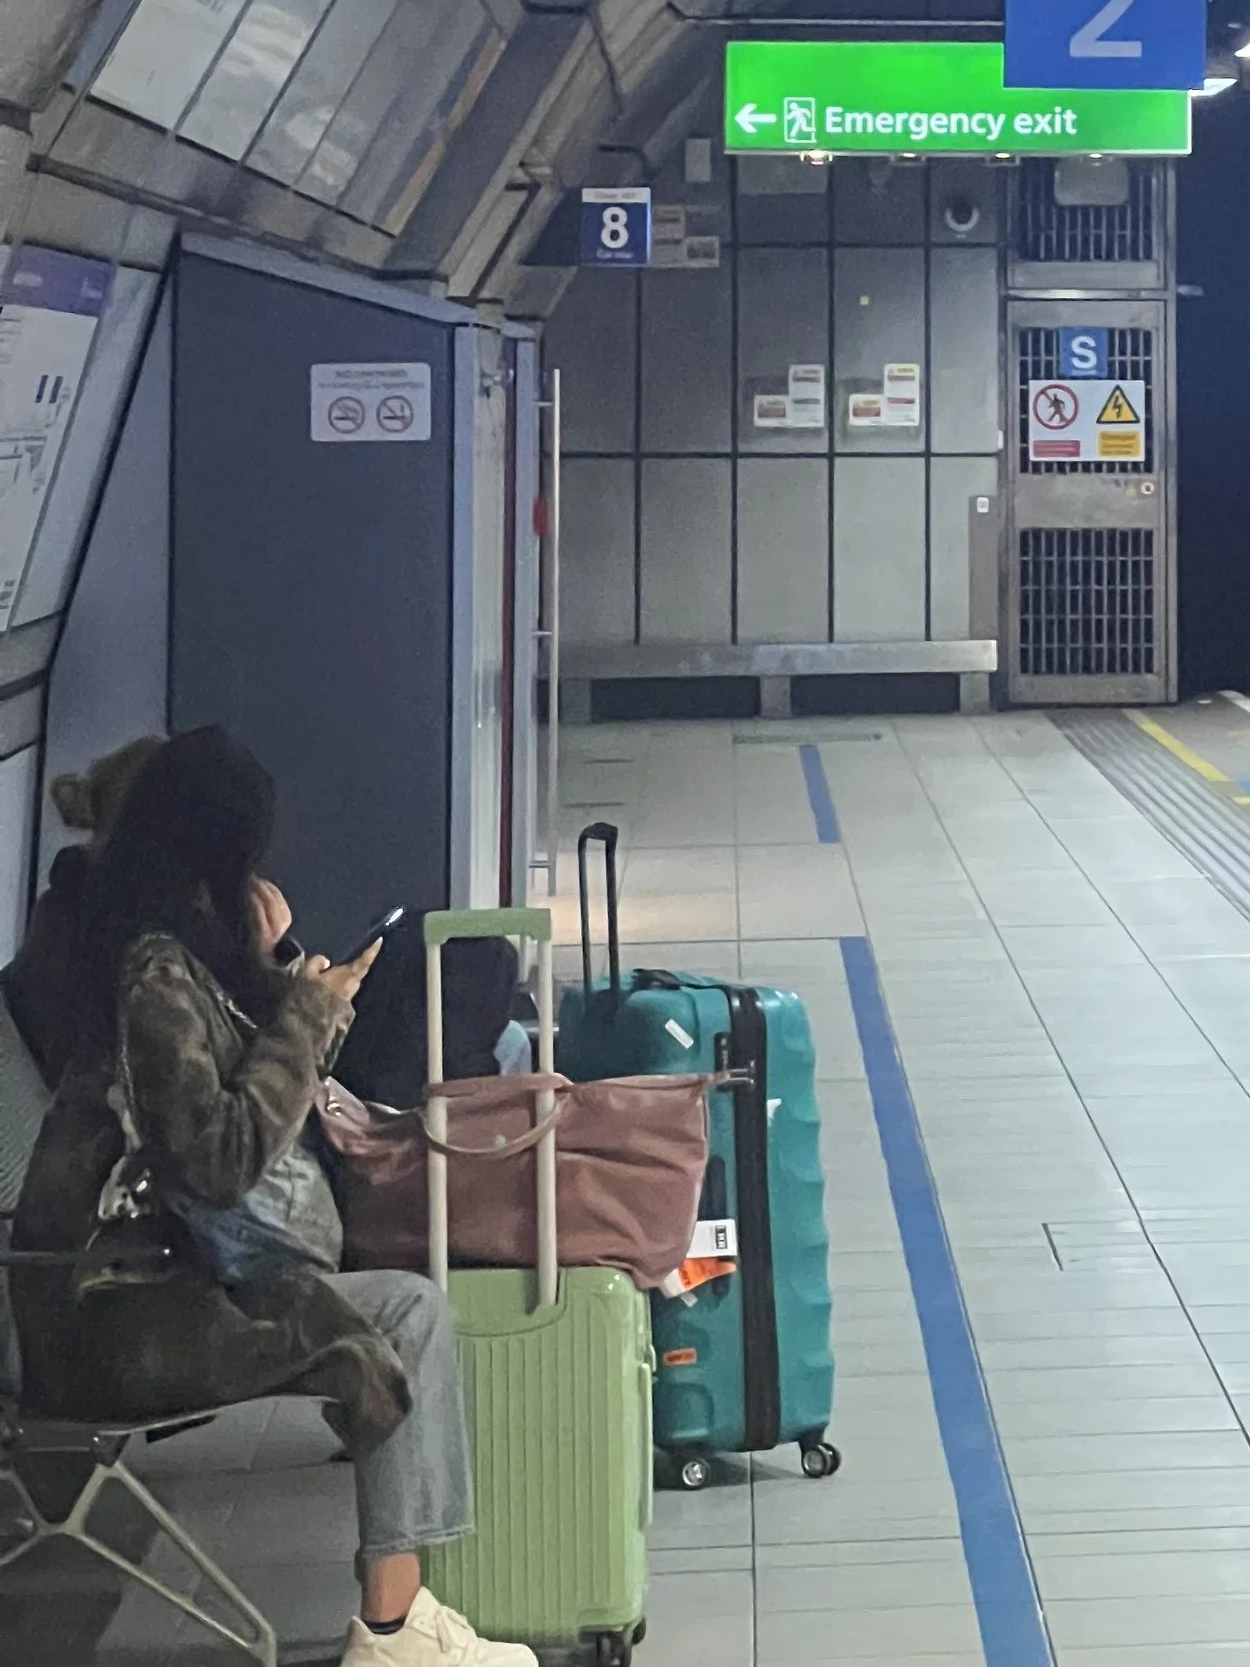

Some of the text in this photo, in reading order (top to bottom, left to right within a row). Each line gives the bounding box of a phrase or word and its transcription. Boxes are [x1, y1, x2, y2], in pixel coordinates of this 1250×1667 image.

[827, 106, 1077, 140] Emergency exit
[601, 206, 629, 249] 8
[1071, 335, 1097, 369] S
